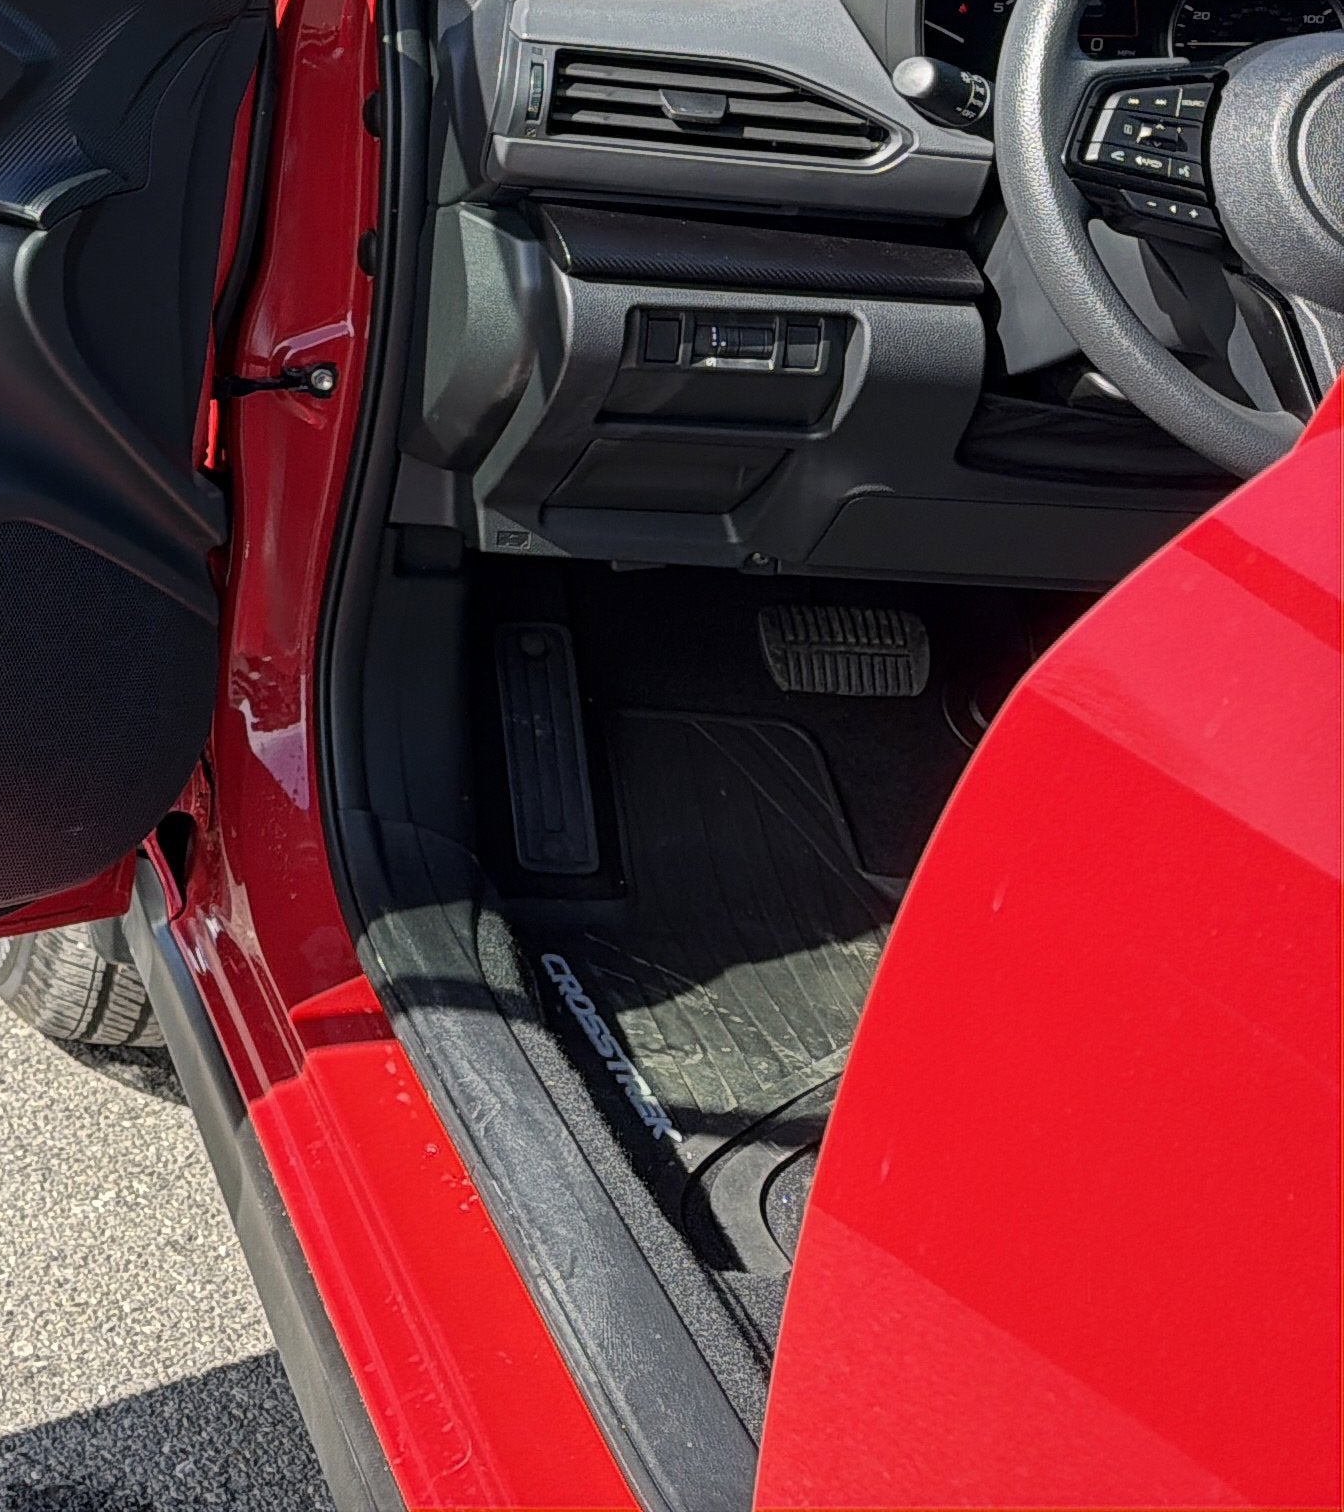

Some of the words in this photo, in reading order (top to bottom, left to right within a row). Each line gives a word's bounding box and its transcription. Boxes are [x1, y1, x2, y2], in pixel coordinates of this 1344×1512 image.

[992, 2, 1004, 13] 5
[1192, 11, 1211, 21] 20
[1302, 15, 1325, 25] 100
[1090, 38, 1104, 51] 0
[541, 953, 683, 1143] CROSSTREK
